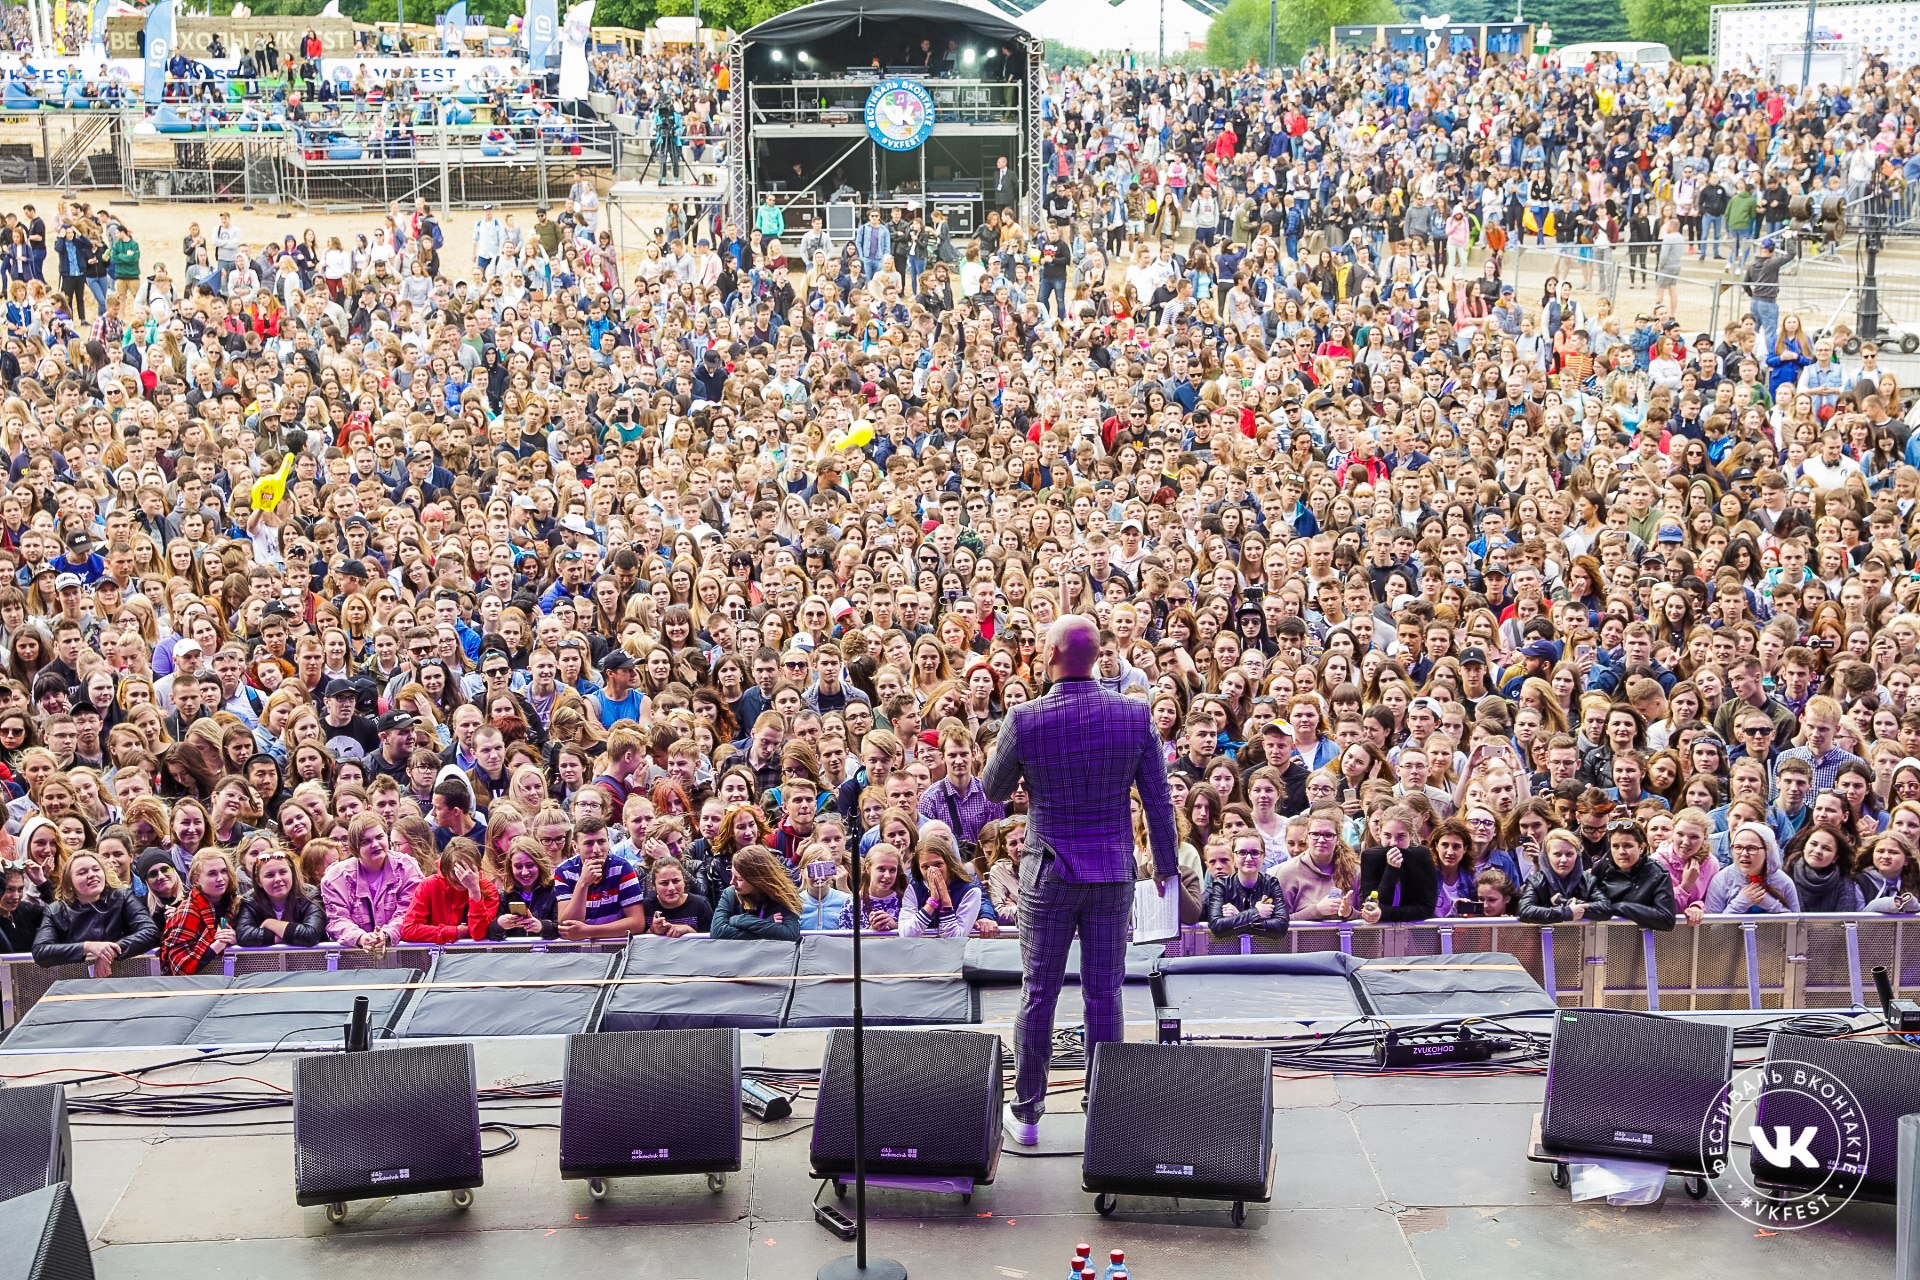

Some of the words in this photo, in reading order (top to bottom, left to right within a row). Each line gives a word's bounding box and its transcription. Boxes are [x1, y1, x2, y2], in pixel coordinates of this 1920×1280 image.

[110, 31, 249, 53] ВЕХОДЫ
[866, 81, 899, 129] ФЕСТИВАЛЬ
[901, 81, 934, 127] ВКОНТАКТЕ
